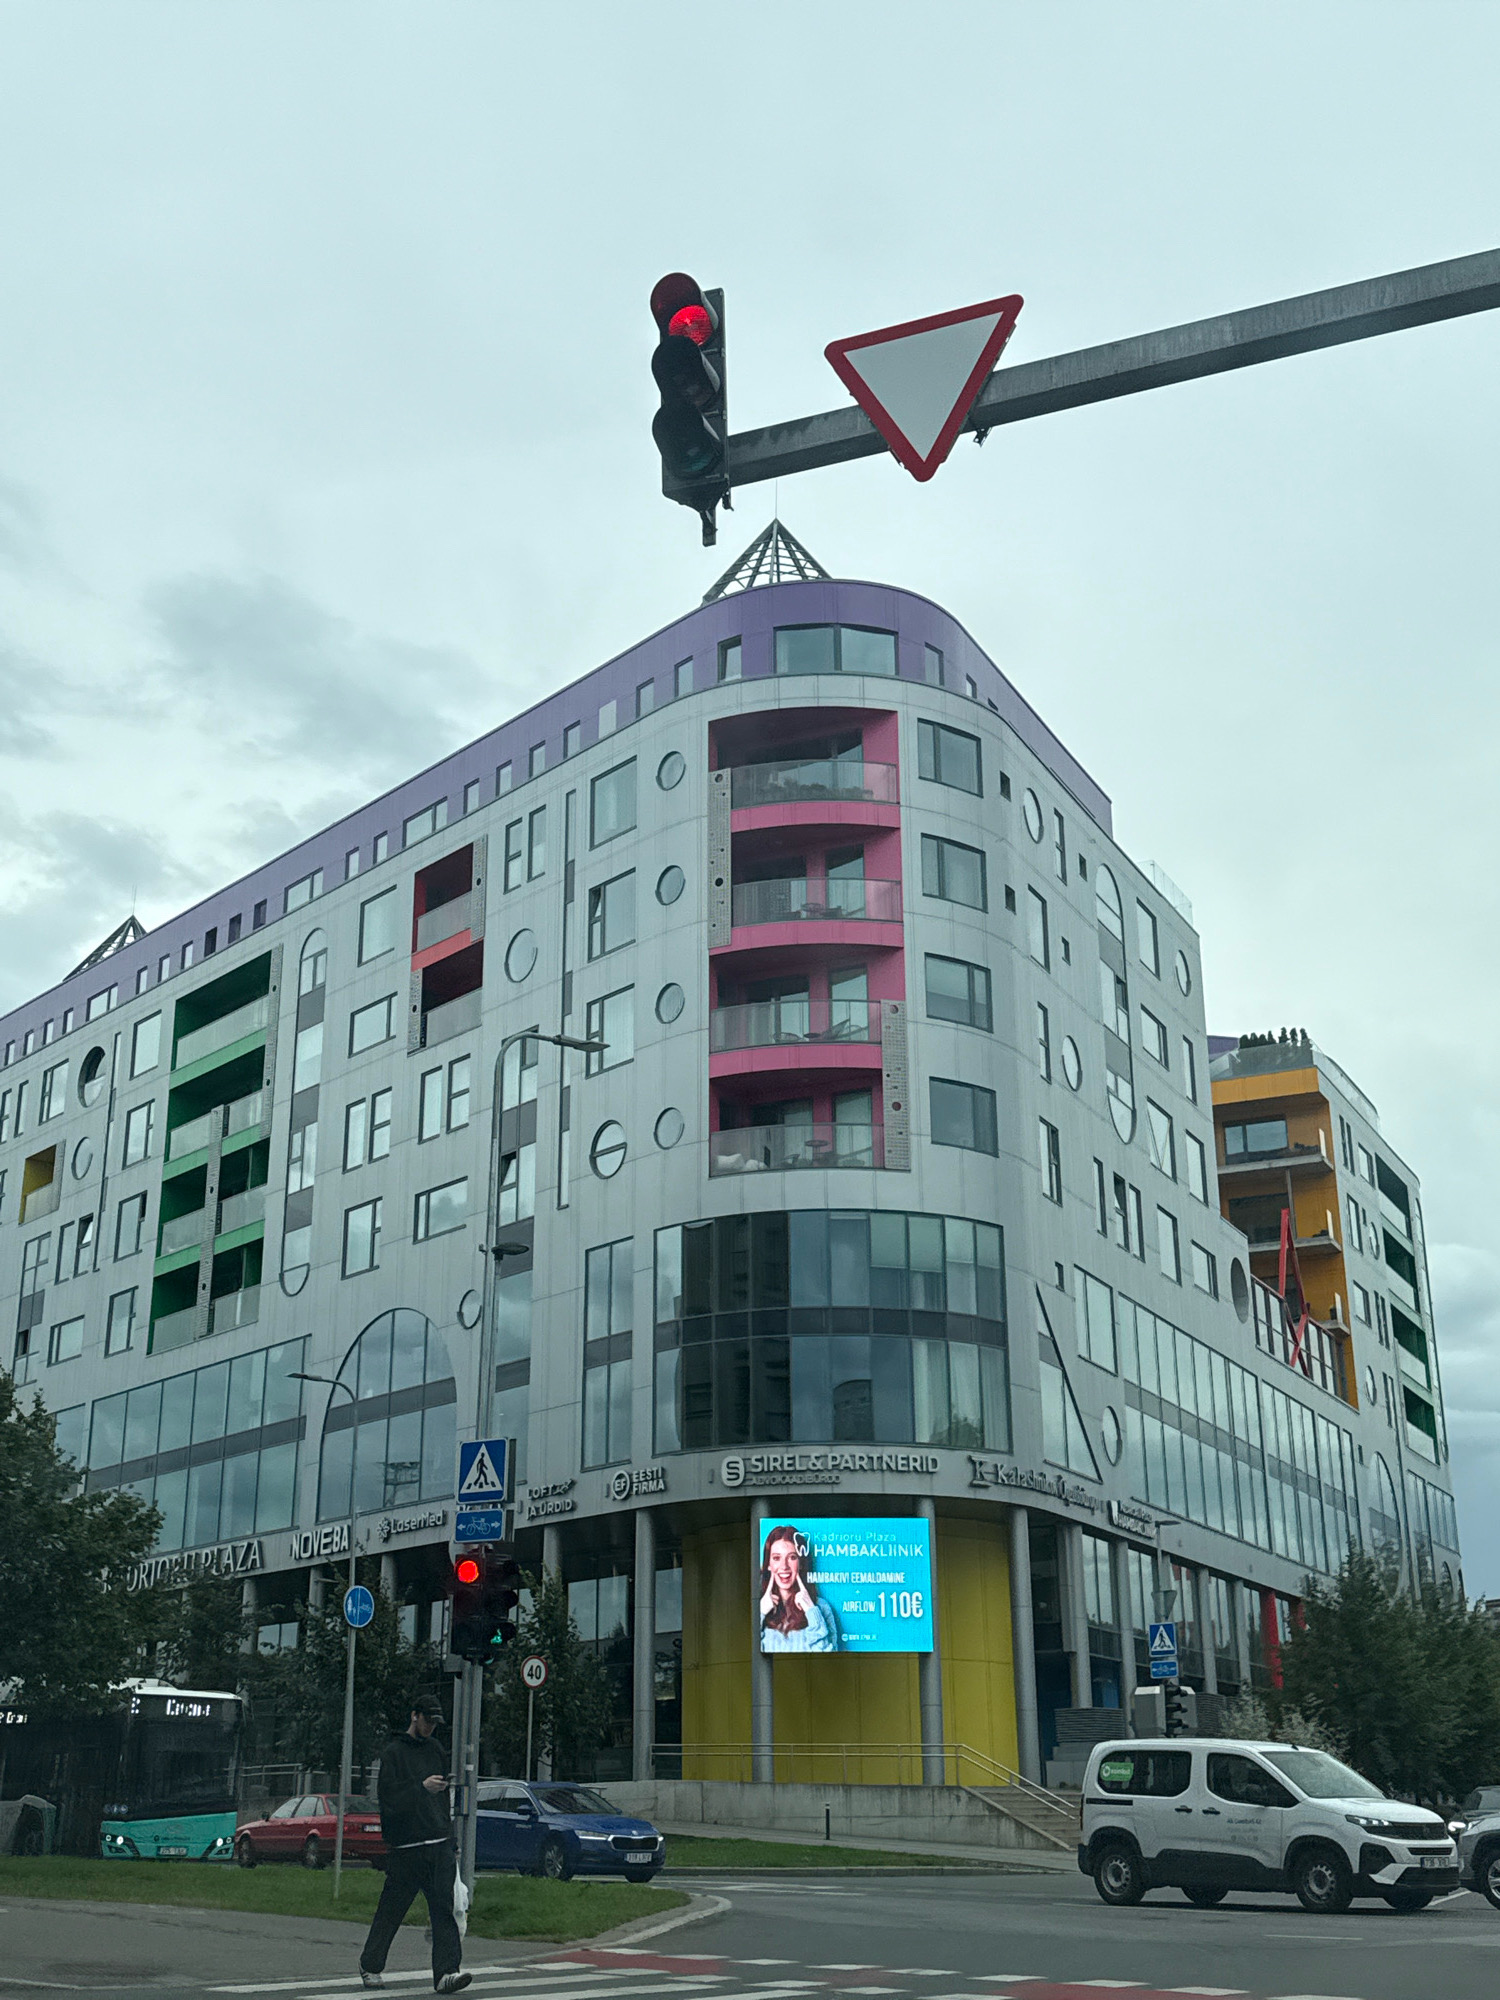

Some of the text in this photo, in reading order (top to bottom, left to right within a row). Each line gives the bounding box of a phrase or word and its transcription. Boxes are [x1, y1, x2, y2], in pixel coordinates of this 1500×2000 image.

[751, 1454, 940, 1473] SIREL & PARTNERID
[632, 1466, 663, 1482] EESTI
[527, 1483, 554, 1500] LOFT
[614, 1479, 627, 1492] EF
[632, 1479, 666, 1496] FIRMA
[391, 1509, 445, 1535] LaserMed
[292, 1524, 350, 1560] NOVEBA
[813, 1532, 897, 1542] Kadrioru Plaza
[814, 1543, 924, 1557] HAMBAKLIINIK
[806, 1571, 906, 1584] HAMBAKIVI EEMALDAMINE
[842, 1591, 924, 1618] AIRFLOW 110€
[527, 1664, 542, 1680] 40
